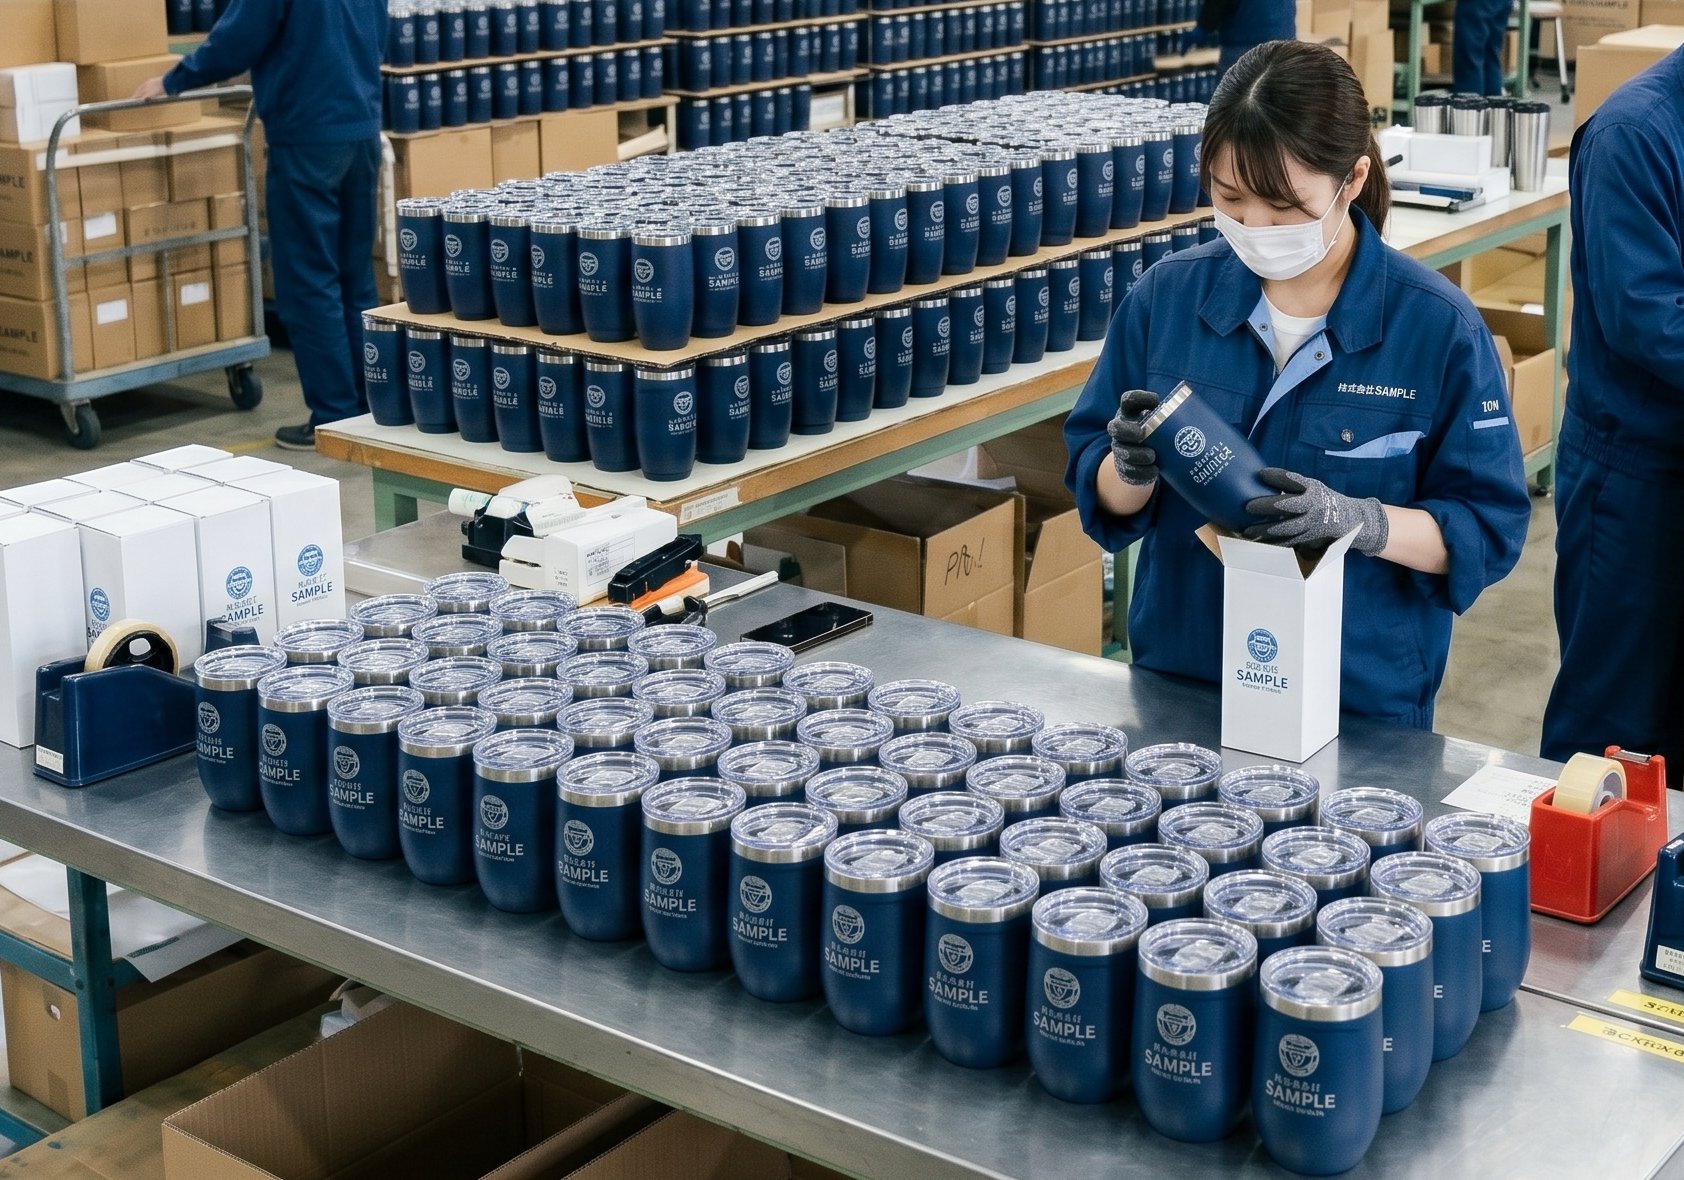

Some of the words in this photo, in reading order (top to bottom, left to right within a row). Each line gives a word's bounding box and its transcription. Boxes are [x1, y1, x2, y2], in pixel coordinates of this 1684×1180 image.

[291, 581, 333, 602] SAMPLE
[1236, 669, 1288, 689] SAMPLE
[329, 784, 374, 804] SAMPLE
[475, 834, 524, 856] SAMPLE
[644, 888, 697, 912] SAMPLE
[733, 917, 788, 942] SAMPLE
[824, 946, 880, 973] SAMPLE
[928, 976, 989, 1004] SAMPLE
[1033, 1010, 1096, 1039] SAMPLE
[1145, 1049, 1212, 1077] SAMPLE
[1265, 1079, 1336, 1109] SAMPLE
